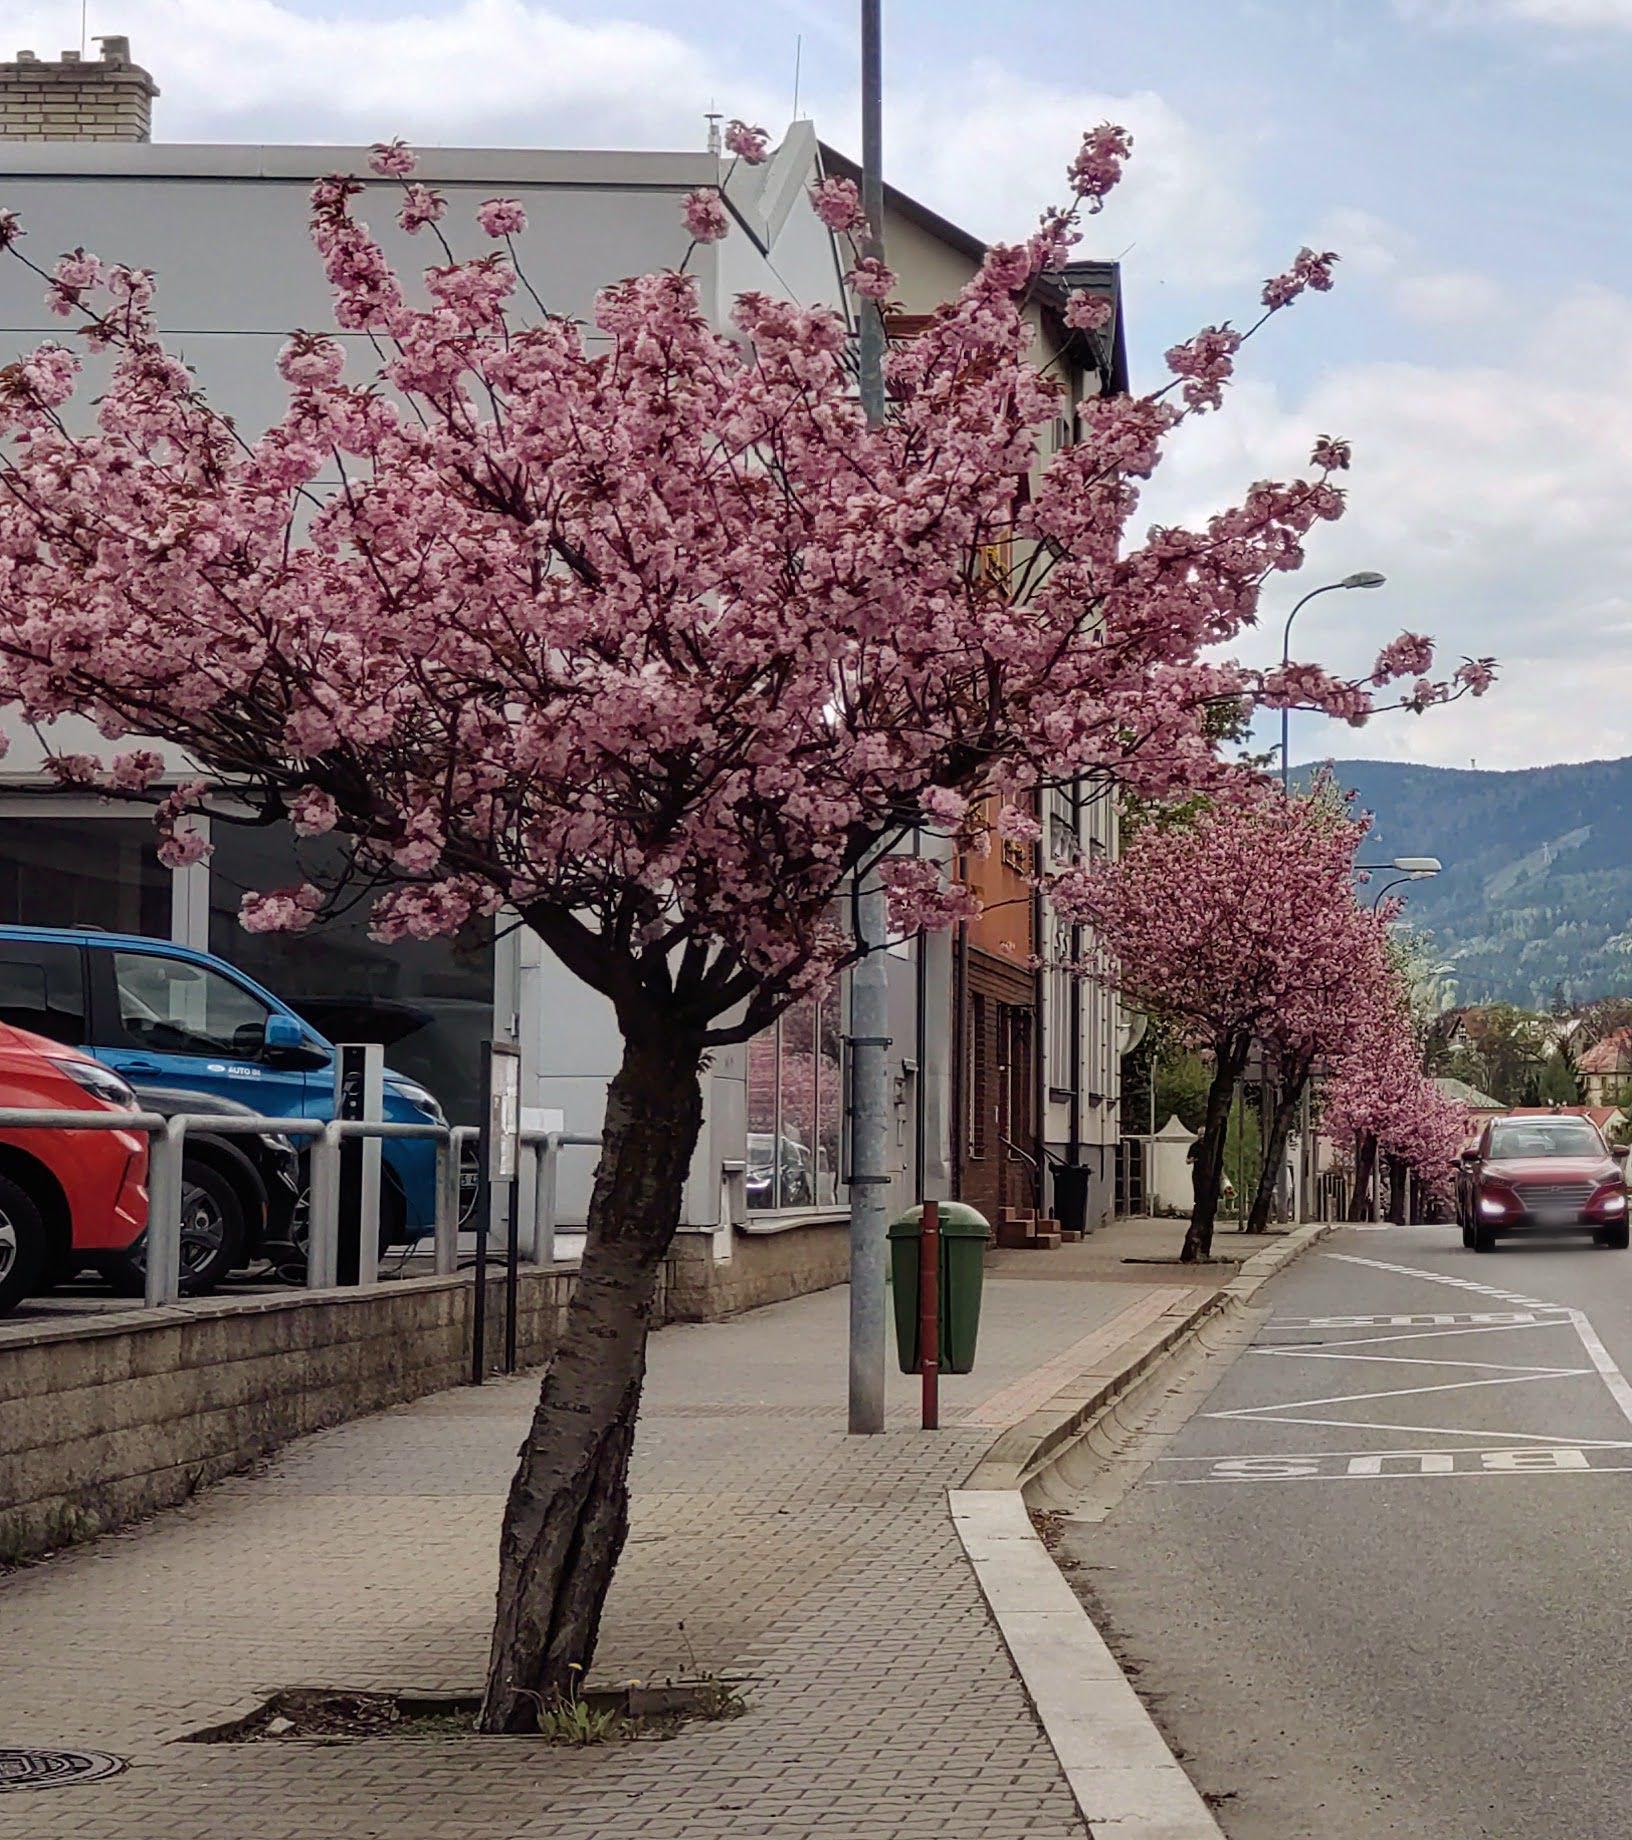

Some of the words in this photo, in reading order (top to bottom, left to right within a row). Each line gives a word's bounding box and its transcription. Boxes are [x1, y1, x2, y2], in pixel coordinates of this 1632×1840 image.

[228, 1066, 251, 1075] AUTO
[1309, 1312, 1536, 1326] BUS
[1209, 1448, 1591, 1478] BUS
